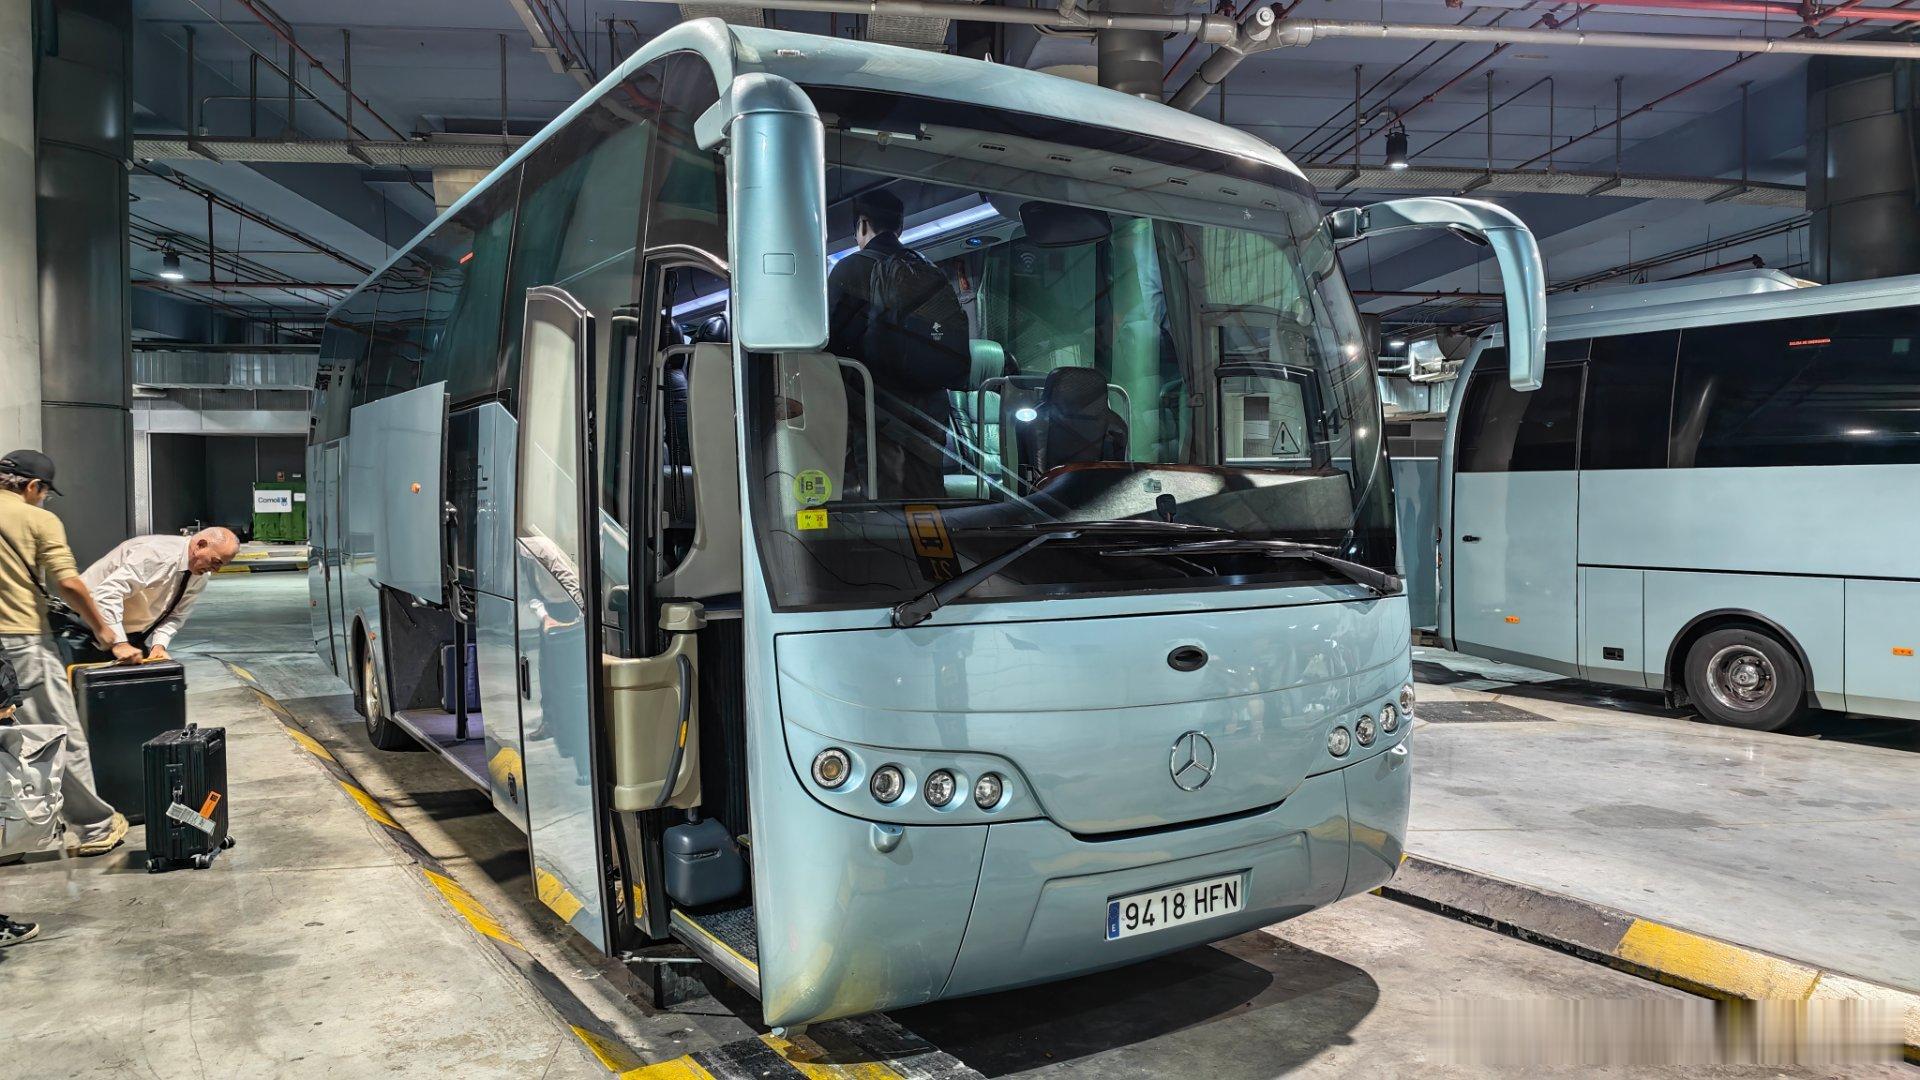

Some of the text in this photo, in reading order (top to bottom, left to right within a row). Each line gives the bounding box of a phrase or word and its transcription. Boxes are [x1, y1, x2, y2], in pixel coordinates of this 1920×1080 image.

[805, 481, 814, 490] B
[1111, 880, 1238, 933] E 9418 HFN
